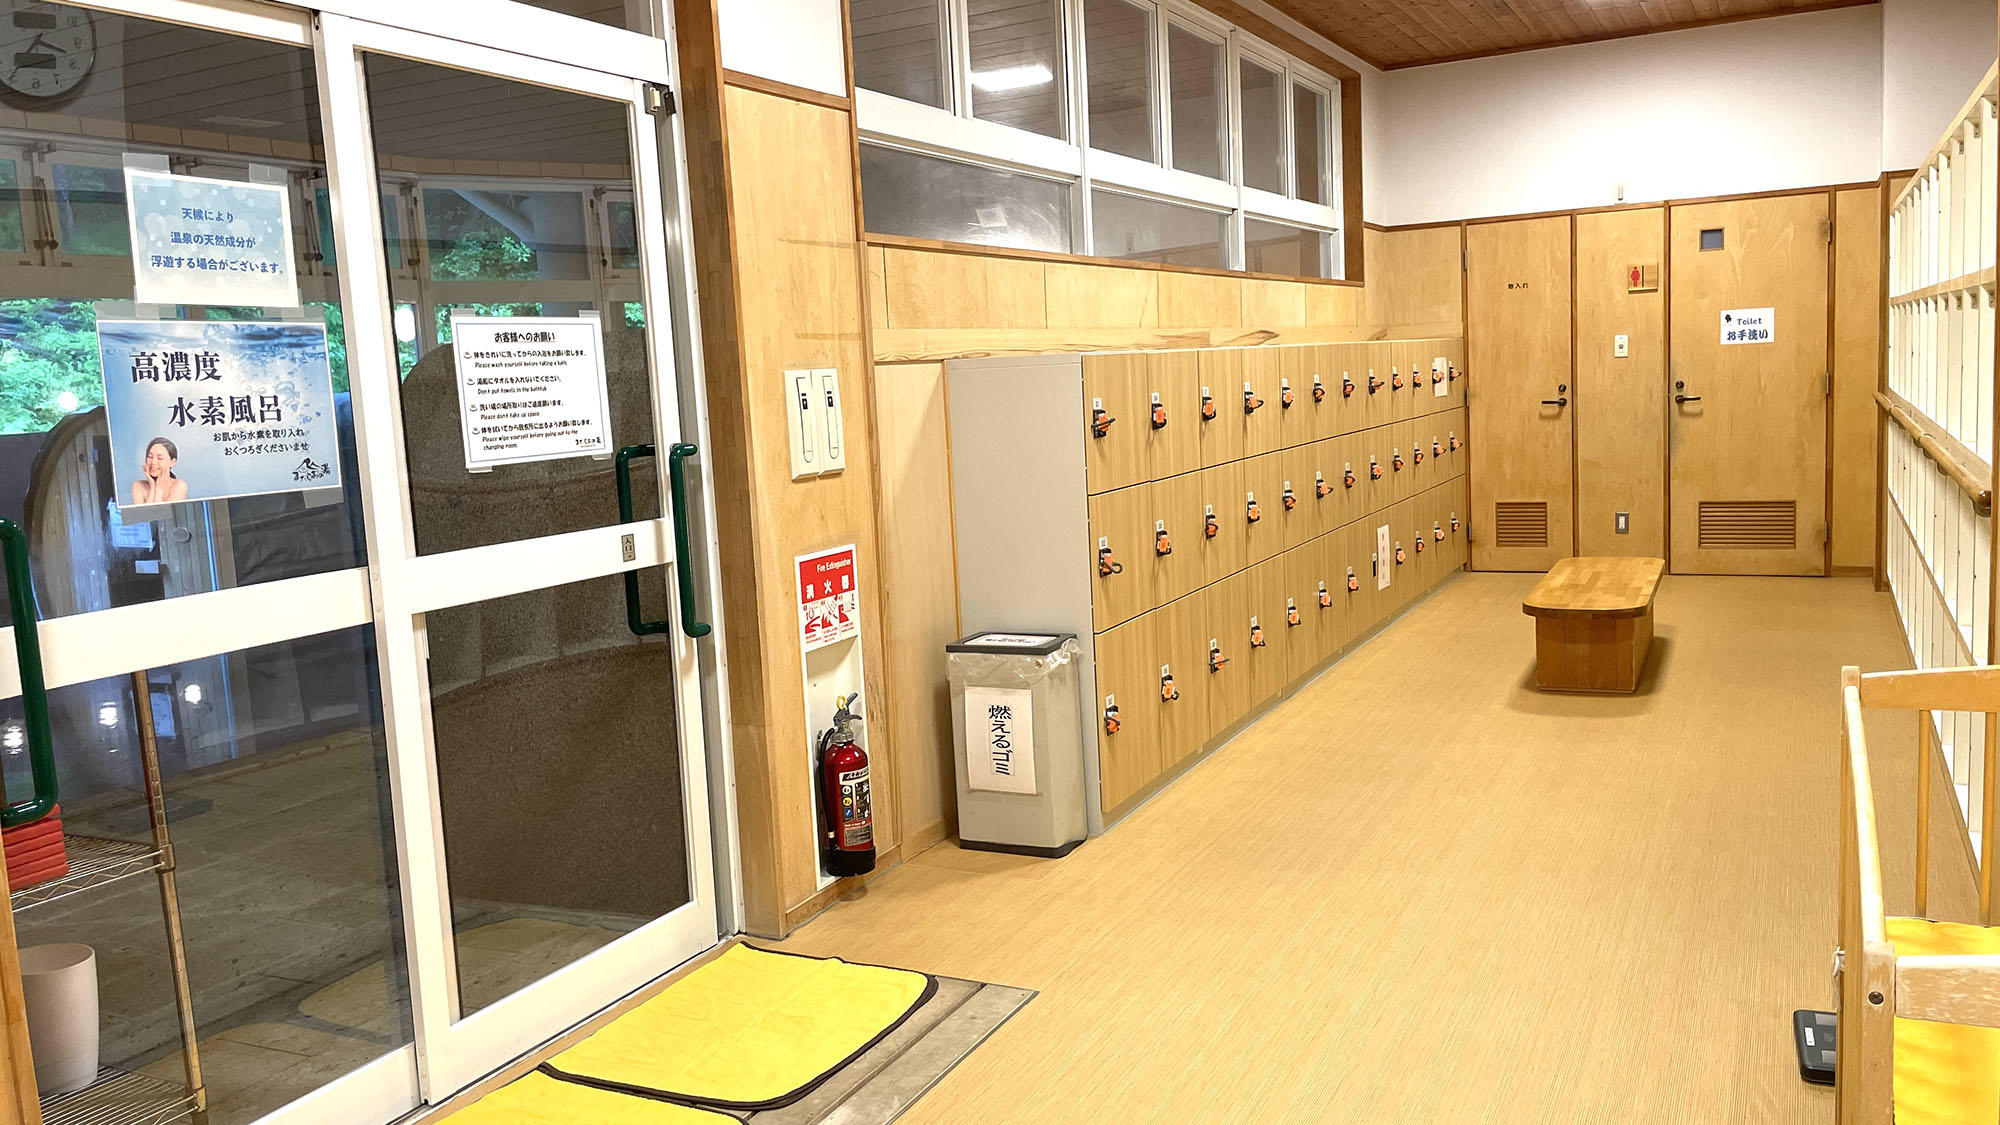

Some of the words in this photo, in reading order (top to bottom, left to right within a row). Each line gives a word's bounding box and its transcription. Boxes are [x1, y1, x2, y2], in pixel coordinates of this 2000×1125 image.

[181, 207, 234, 223] 天候により
[170, 231, 256, 249] 温泉の天然成分が
[151, 255, 284, 275] 浮遊する場合がございます。
[1737, 316, 1762, 325] Toilet
[494, 332, 555, 342] お客様へのお願い
[1727, 329, 1768, 341] お手洗い
[129, 351, 222, 383] 高濃度
[504, 360, 523, 368] yourself
[168, 394, 282, 427] 水素風呂
[482, 435, 498, 443] Please
[499, 434, 509, 442] wipe
[510, 433, 529, 441] yourself
[530, 432, 545, 440] before
[545, 431, 557, 440] going
[224, 442, 309, 456] おくつろぎくださいませ
[483, 442, 504, 451] changing
[816, 562, 826, 573] Fire
[826, 558, 852, 572] Extinguisher
[988, 704, 1013, 775] 燃えるゴミ
